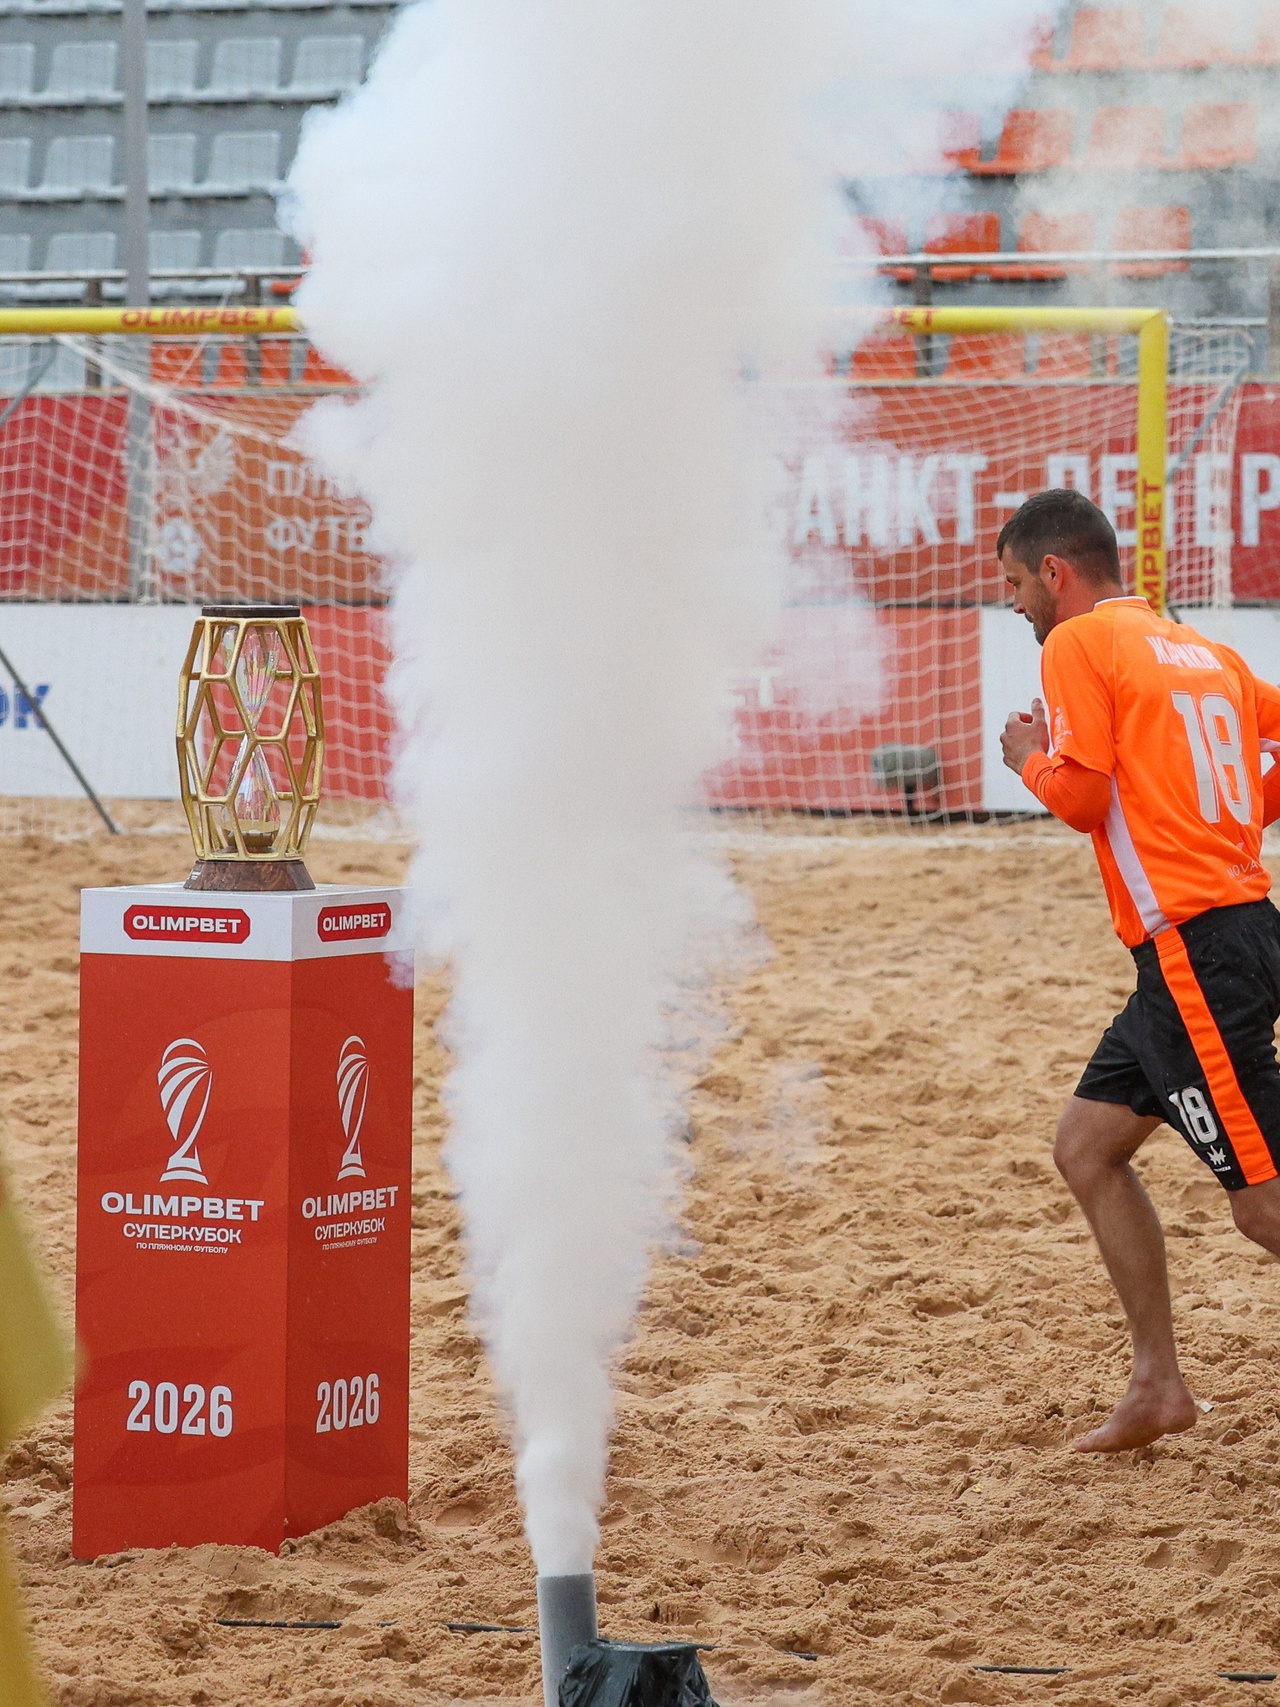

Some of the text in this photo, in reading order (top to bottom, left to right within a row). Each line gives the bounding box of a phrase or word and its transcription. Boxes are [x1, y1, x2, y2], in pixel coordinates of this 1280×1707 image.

[121, 309, 278, 327] OLIMPBET
[265, 515, 367, 552] ФУТБ
[1142, 477, 1161, 613] MPBET
[1171, 690, 1252, 826] 18
[132, 914, 242, 934] OLIMPBET
[322, 912, 387, 931] OLIMPBET
[1168, 1086, 1219, 1145] 18
[100, 1192, 265, 1221] OLIMPBET
[301, 1186, 398, 1219] OLIMPBET
[123, 1222, 242, 1244] СУПЕРКУБОК
[314, 1217, 386, 1241] СУПЕРКУБОК
[136, 1242, 229, 1254] ПО ПЛЯЖНОМУ ФУТБОЛУ
[127, 1380, 233, 1438] 2026
[316, 1373, 380, 1433] 2026
